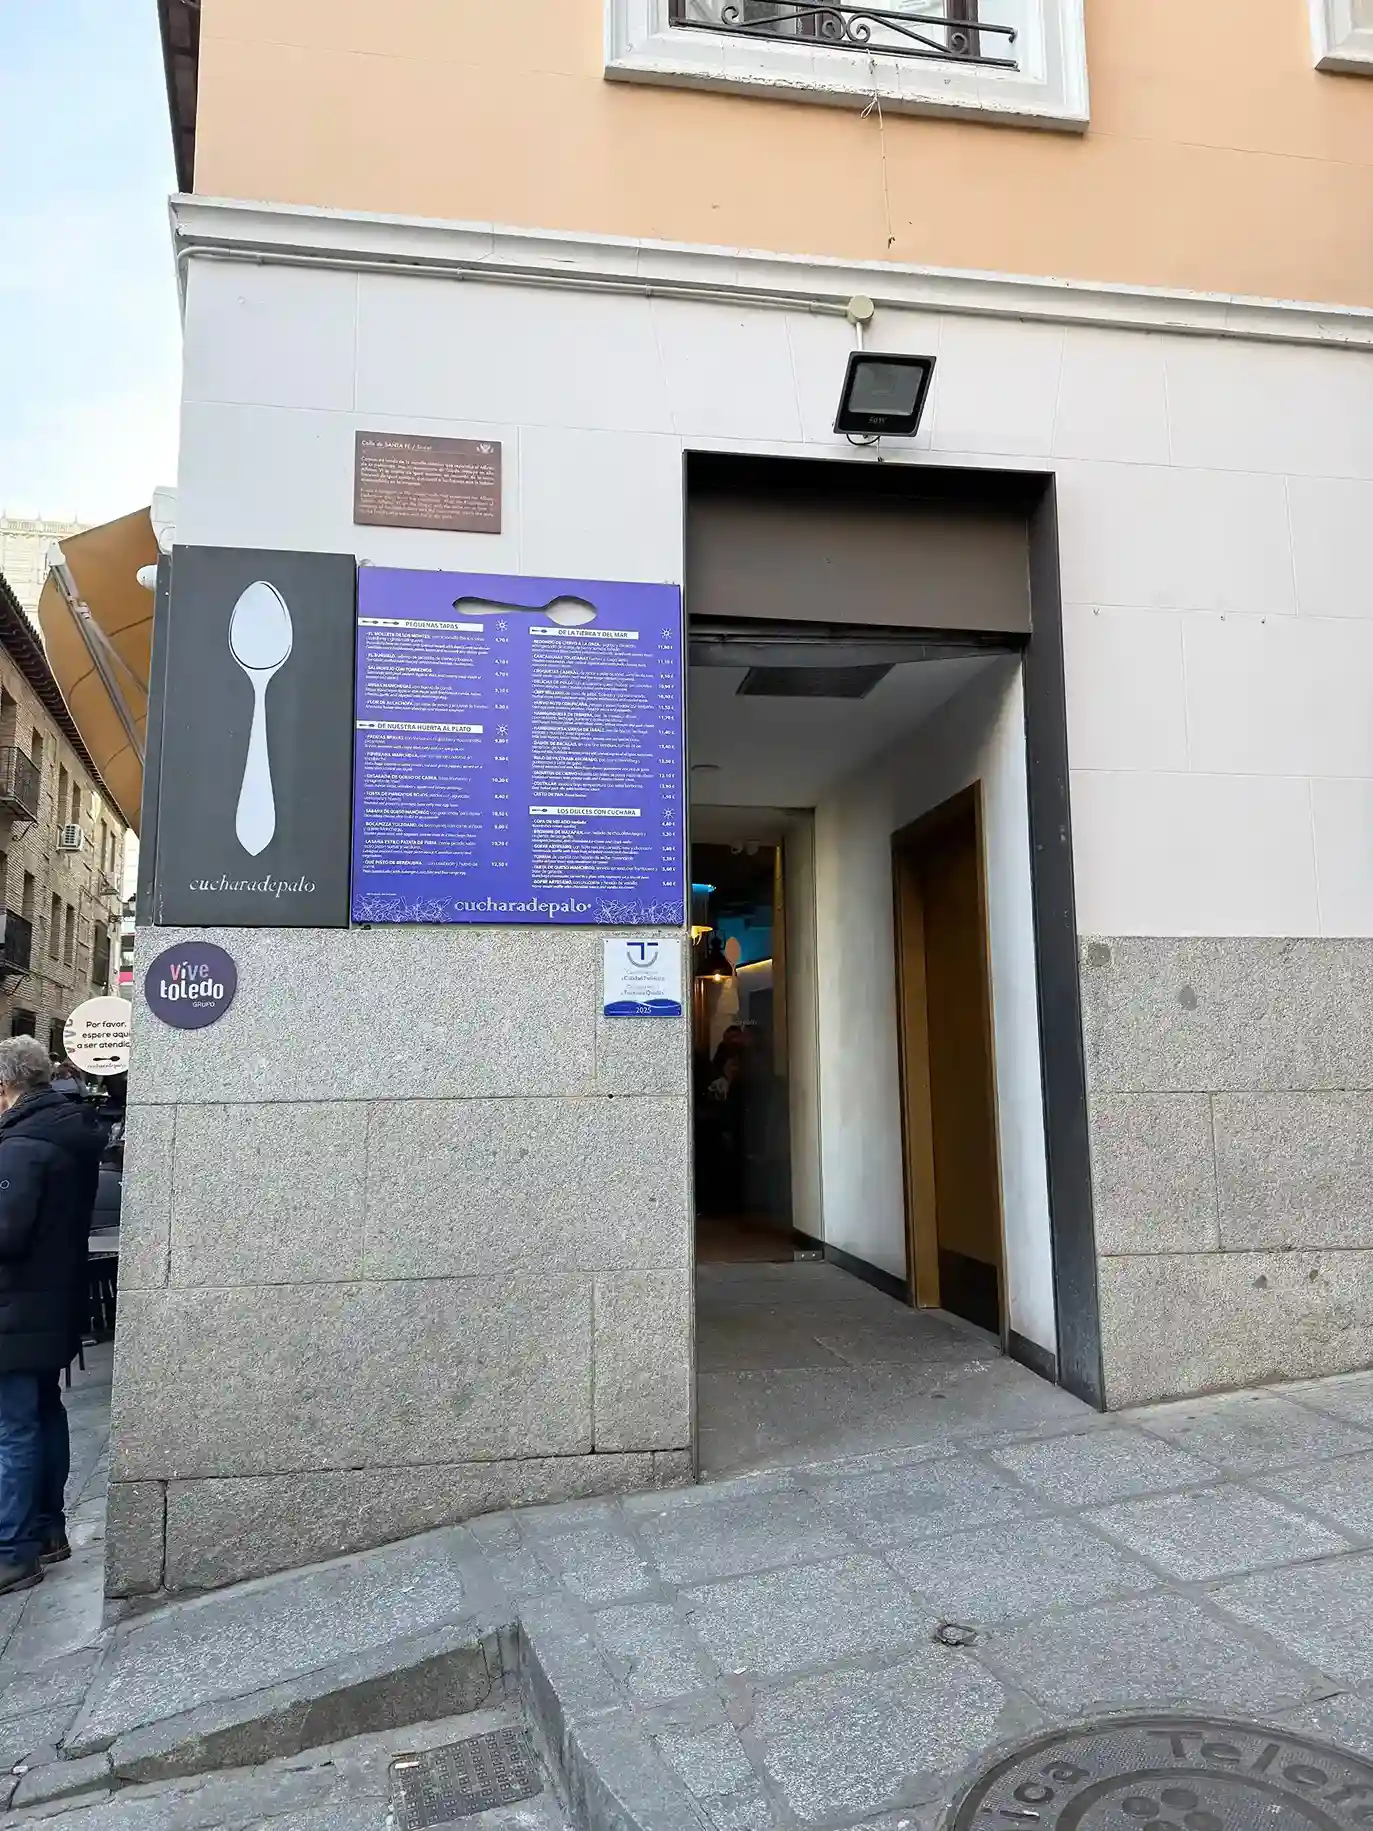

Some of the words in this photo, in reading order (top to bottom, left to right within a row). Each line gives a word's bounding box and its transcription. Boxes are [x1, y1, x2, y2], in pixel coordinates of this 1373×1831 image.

[190, 874, 316, 898] cucharadepalo
[454, 897, 586, 918] cucharadepalo
[160, 978, 224, 1000] toledo
